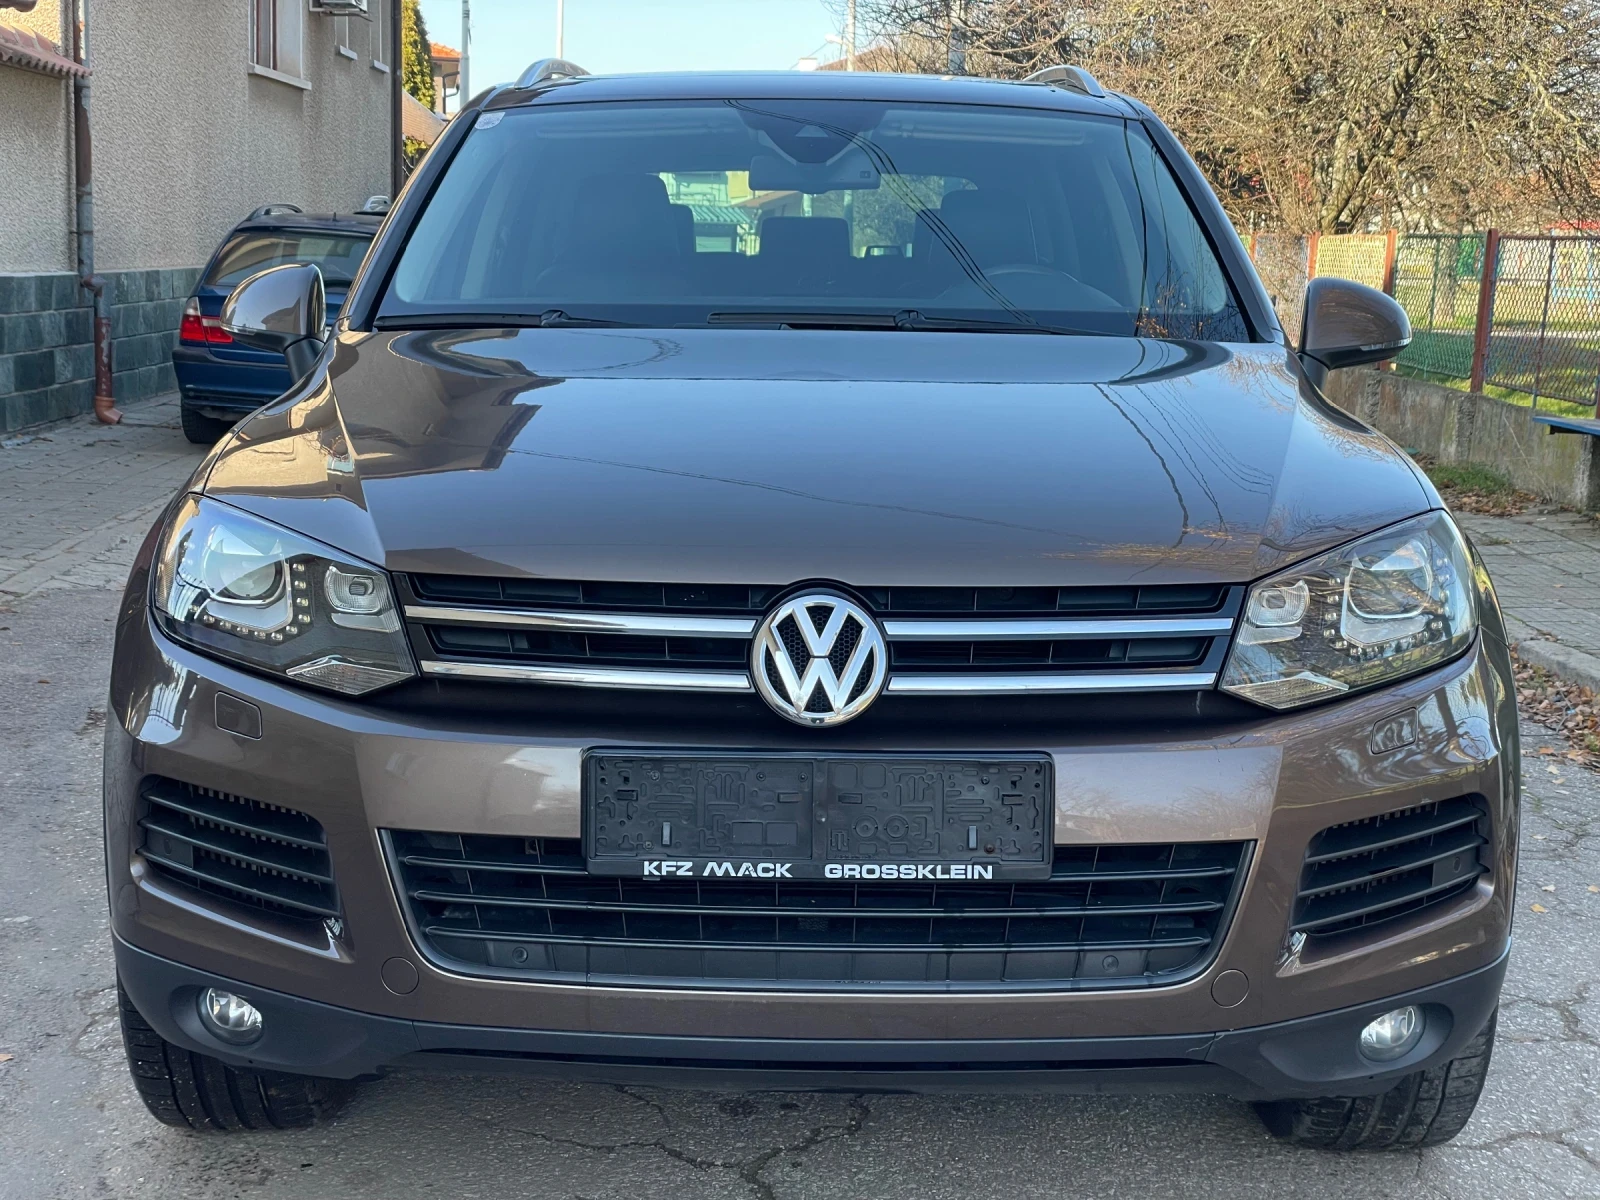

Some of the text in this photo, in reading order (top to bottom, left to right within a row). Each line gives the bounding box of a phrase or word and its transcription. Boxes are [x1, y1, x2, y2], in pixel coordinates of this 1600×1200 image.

[753, 595, 887, 727] VW
[643, 860, 993, 880] KFZ MACK GROSSKLEIN
